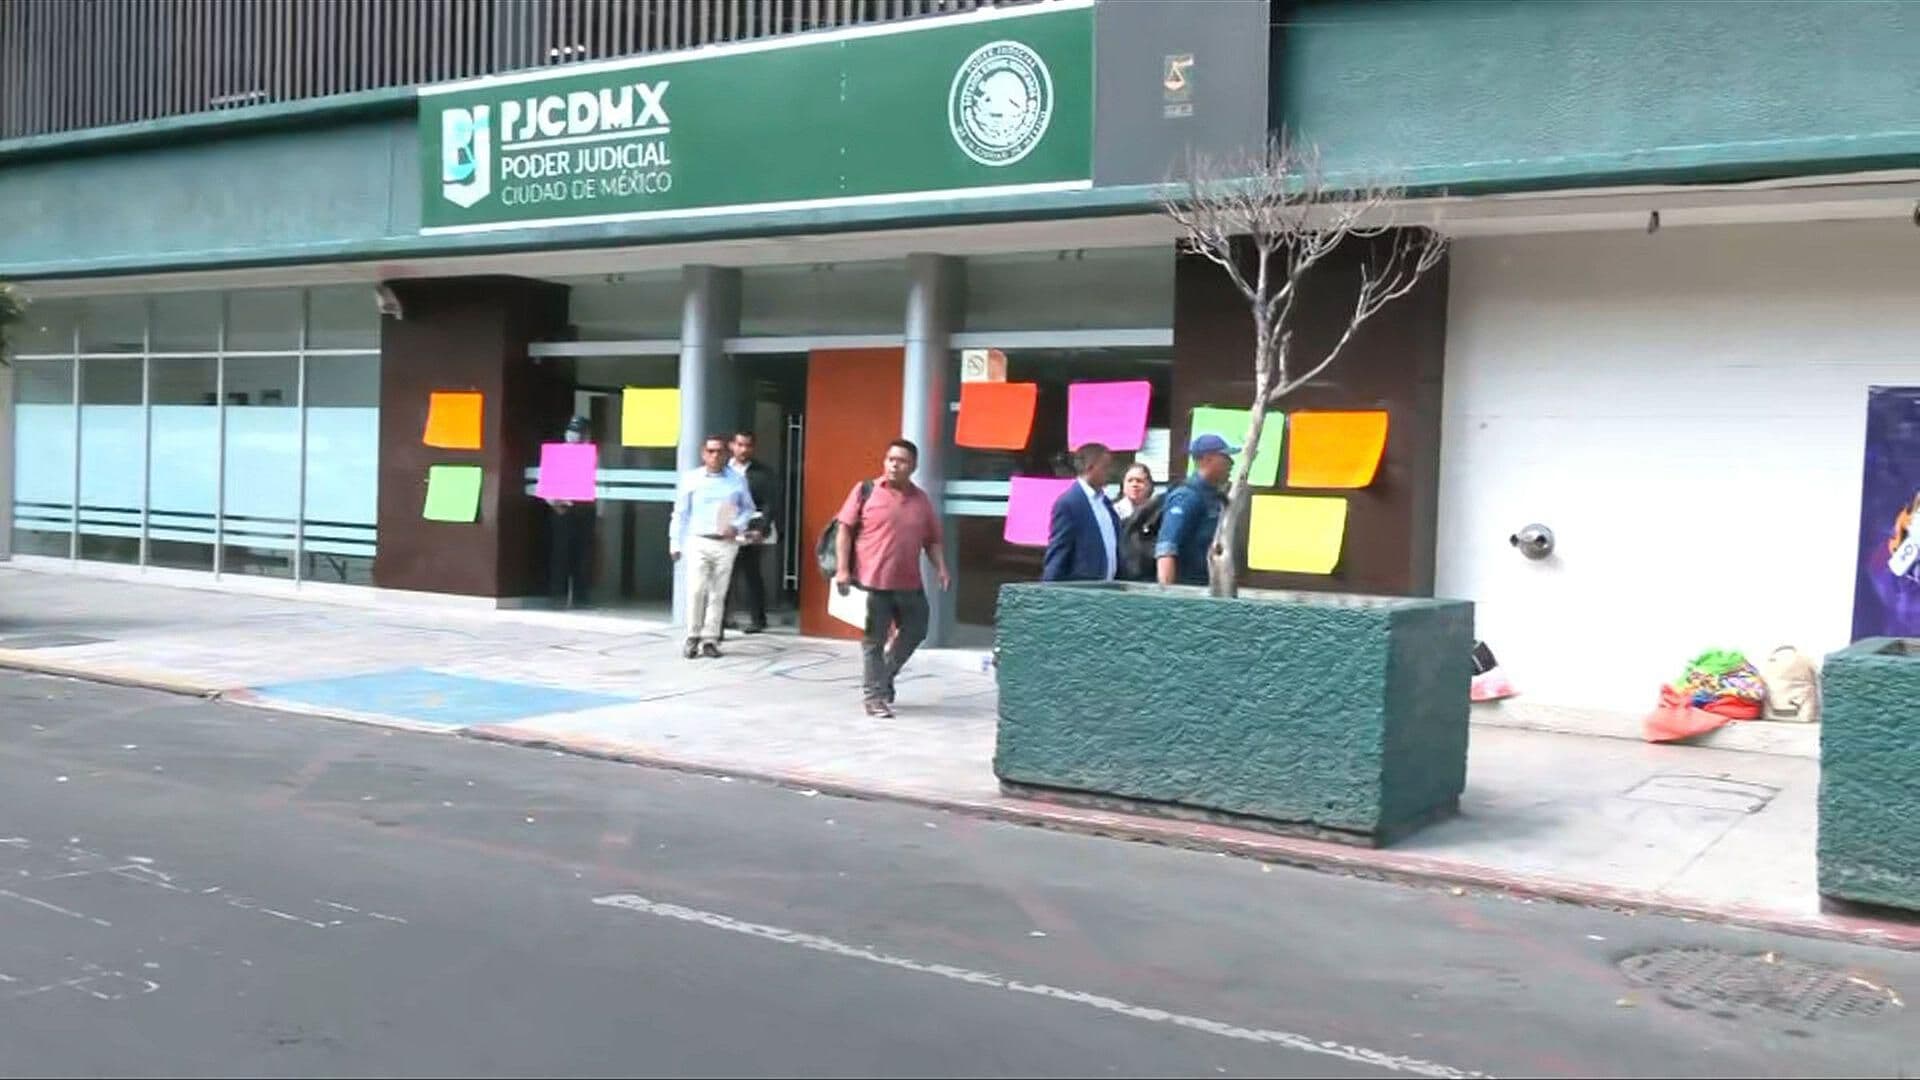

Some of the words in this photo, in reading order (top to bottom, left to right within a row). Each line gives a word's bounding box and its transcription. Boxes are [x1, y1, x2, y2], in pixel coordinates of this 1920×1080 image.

[501, 80, 671, 142] PJCDMX
[501, 151, 571, 180] PODER
[574, 141, 672, 174] JUDICIAL
[502, 181, 568, 205] CIUDAD
[572, 179, 597, 200] DE
[601, 170, 673, 196] MÉXICO
